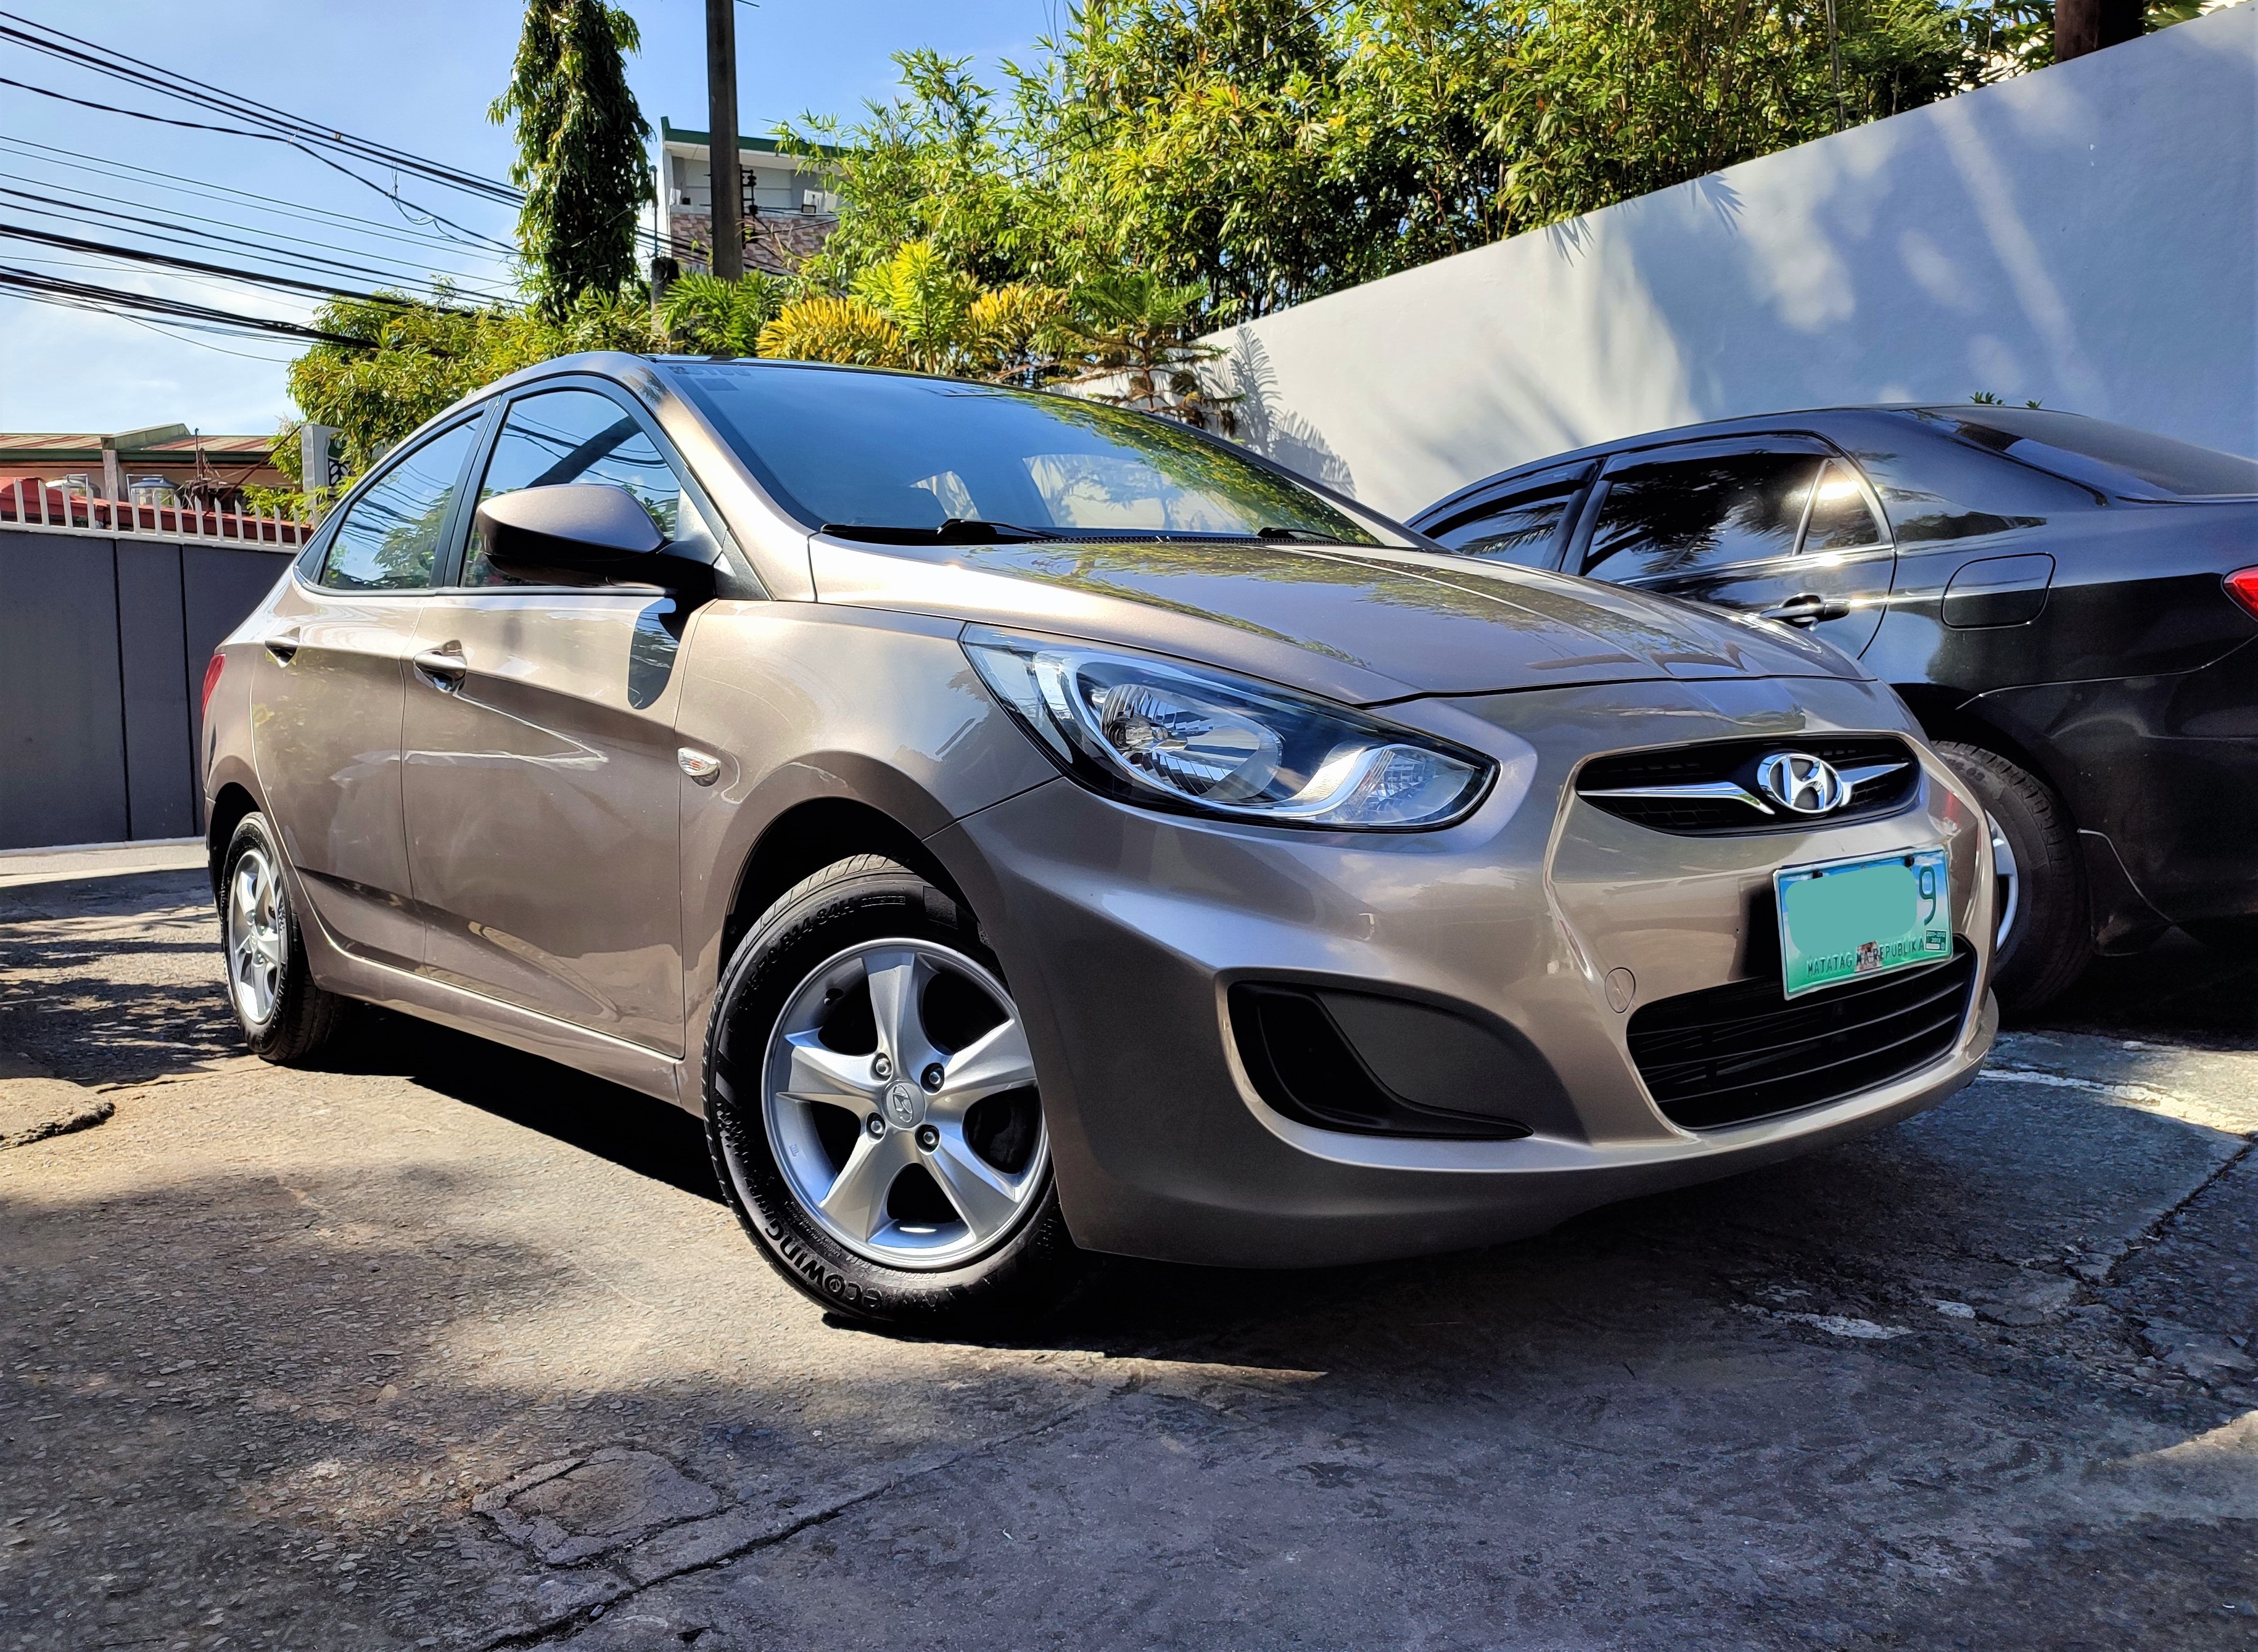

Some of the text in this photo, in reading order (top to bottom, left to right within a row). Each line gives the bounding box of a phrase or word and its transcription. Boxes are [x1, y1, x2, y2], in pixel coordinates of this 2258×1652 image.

[1918, 864, 1937, 926] 9
[1807, 954, 1852, 977] MATATAG
[1873, 940, 1925, 962] REPUBLIKA
[846, 1254, 872, 1270] 84H
